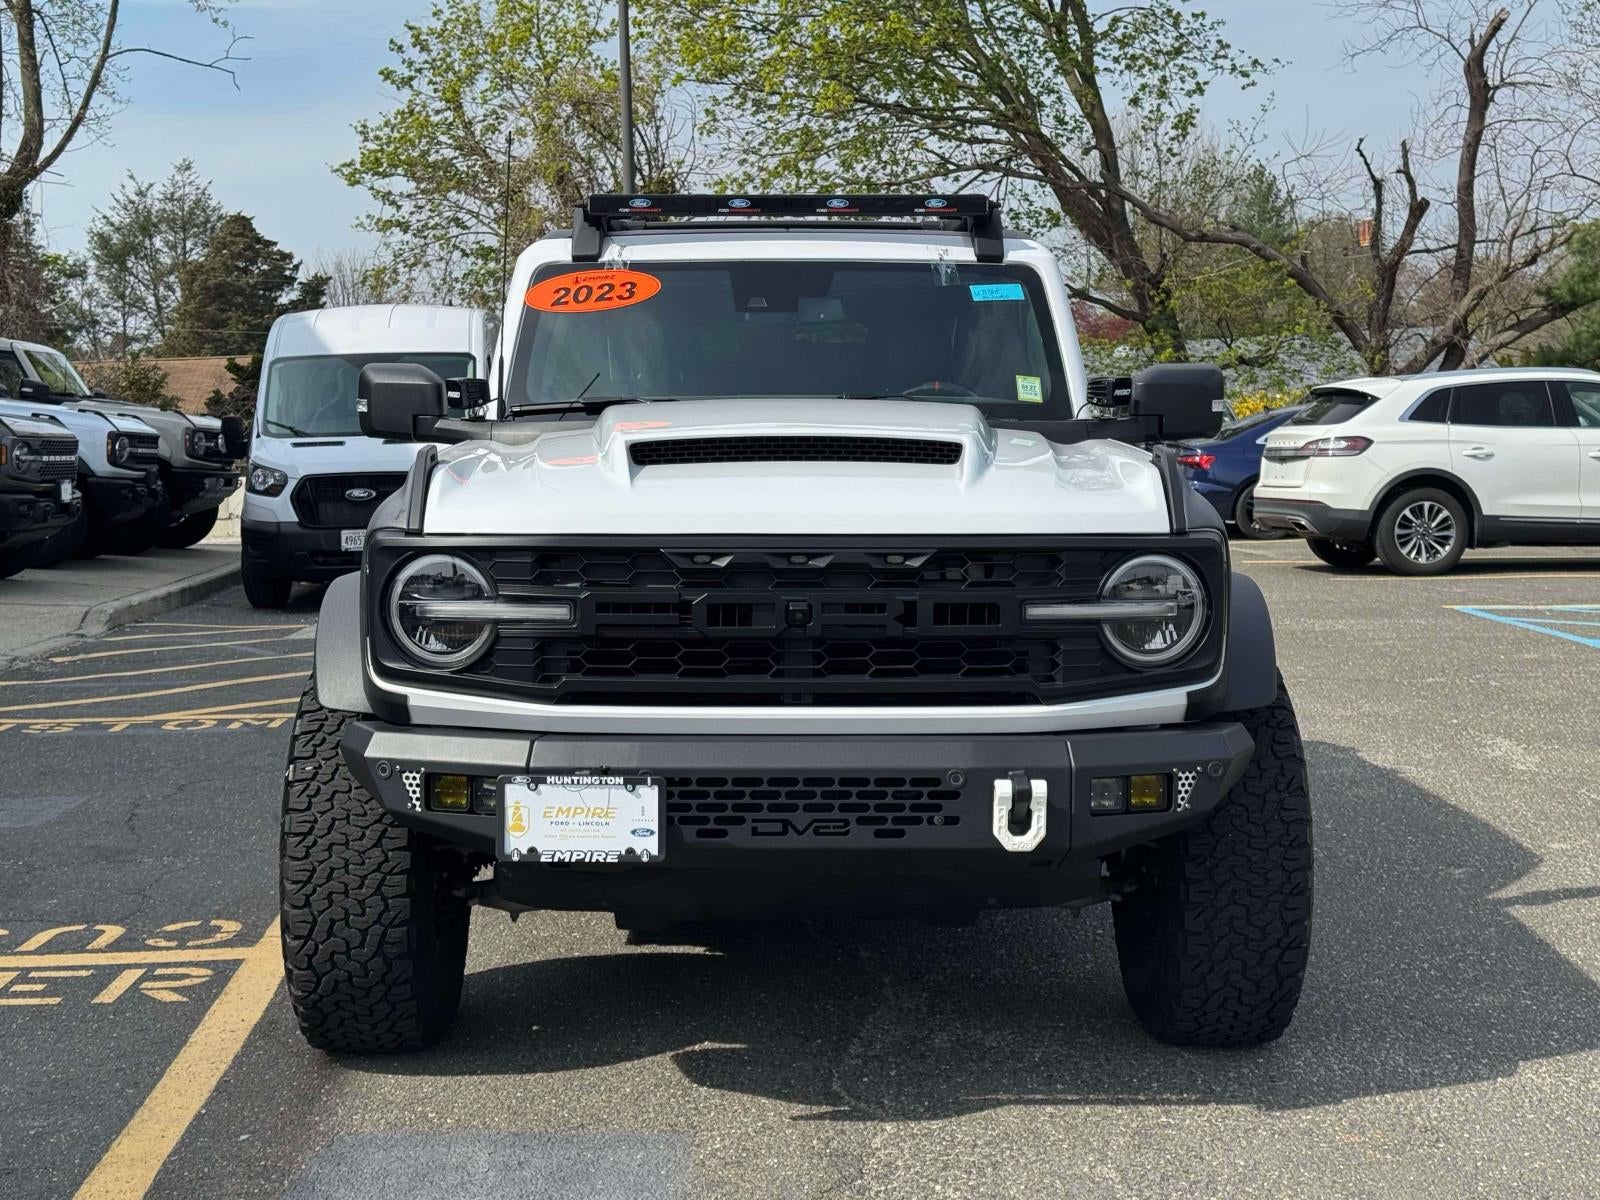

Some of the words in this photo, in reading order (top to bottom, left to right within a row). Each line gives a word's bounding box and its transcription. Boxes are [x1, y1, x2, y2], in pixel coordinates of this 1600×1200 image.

[551, 281, 637, 307] 2023
[348, 489, 372, 499] Ford
[546, 776, 624, 785] HUNTINGTON
[542, 806, 619, 819] EMPIRE
[540, 849, 622, 863] EMPIRE
